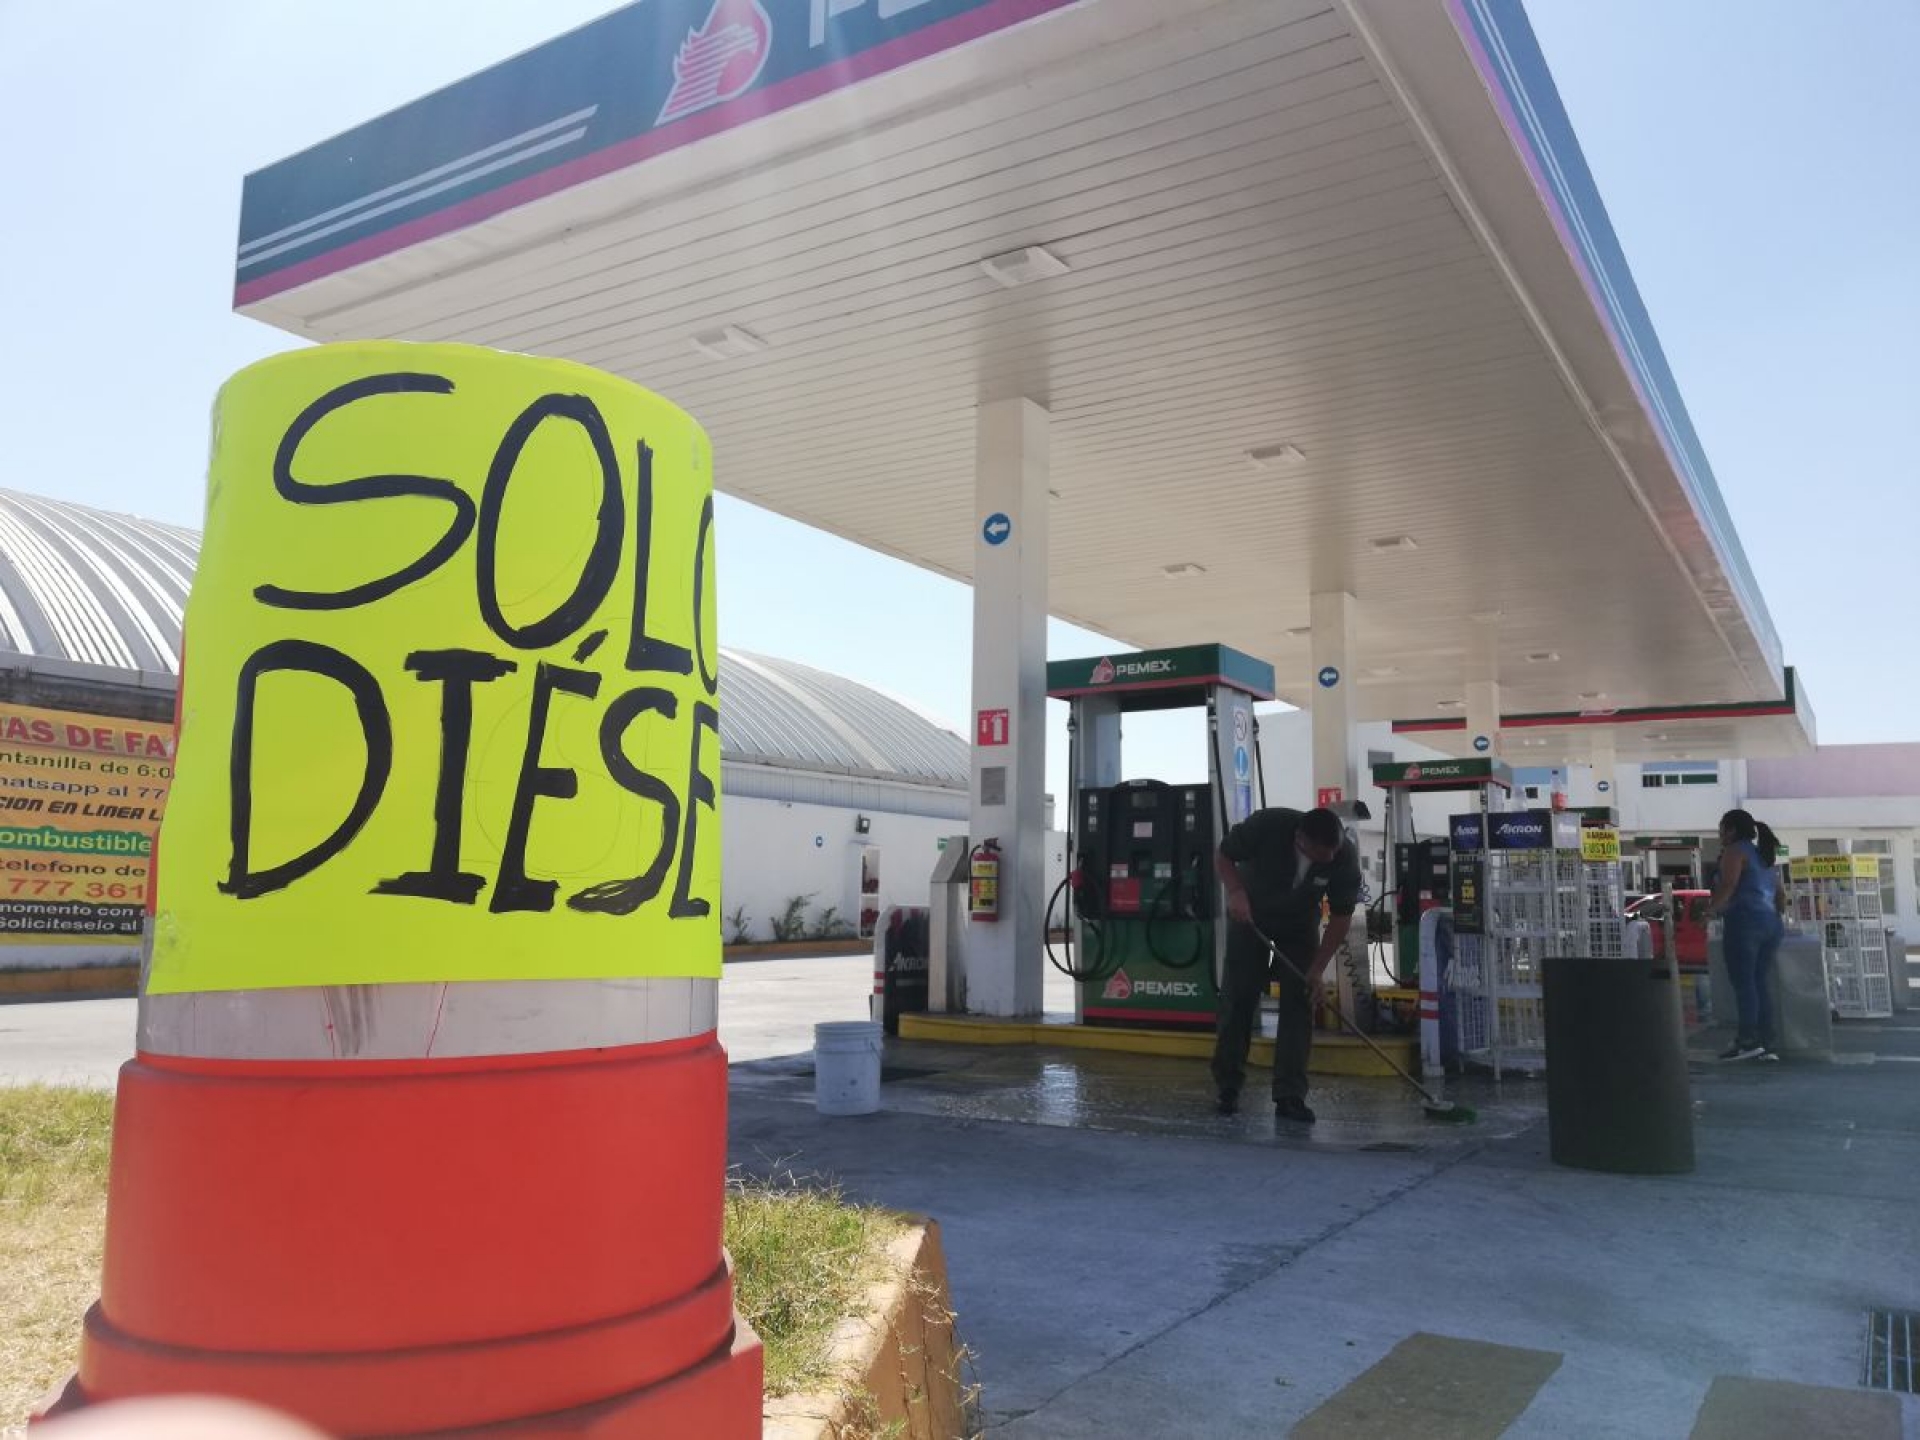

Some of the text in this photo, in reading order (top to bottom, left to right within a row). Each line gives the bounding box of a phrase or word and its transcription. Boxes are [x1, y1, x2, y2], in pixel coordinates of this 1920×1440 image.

[1116, 659, 1171, 676] PEMEX
[0, 716, 54, 743] AS
[66, 724, 116, 751] DE
[100, 761, 129, 775] de
[137, 764, 174, 780] 6:0
[1421, 766, 1460, 776] PEMEX
[107, 785, 129, 798] al
[137, 786, 166, 800] 77
[48, 801, 78, 815] EN
[115, 865, 146, 877] de
[8, 878, 144, 900] 777 361
[97, 907, 134, 917] con
[120, 920, 137, 931] al
[1134, 981, 1198, 997] PEMEX
